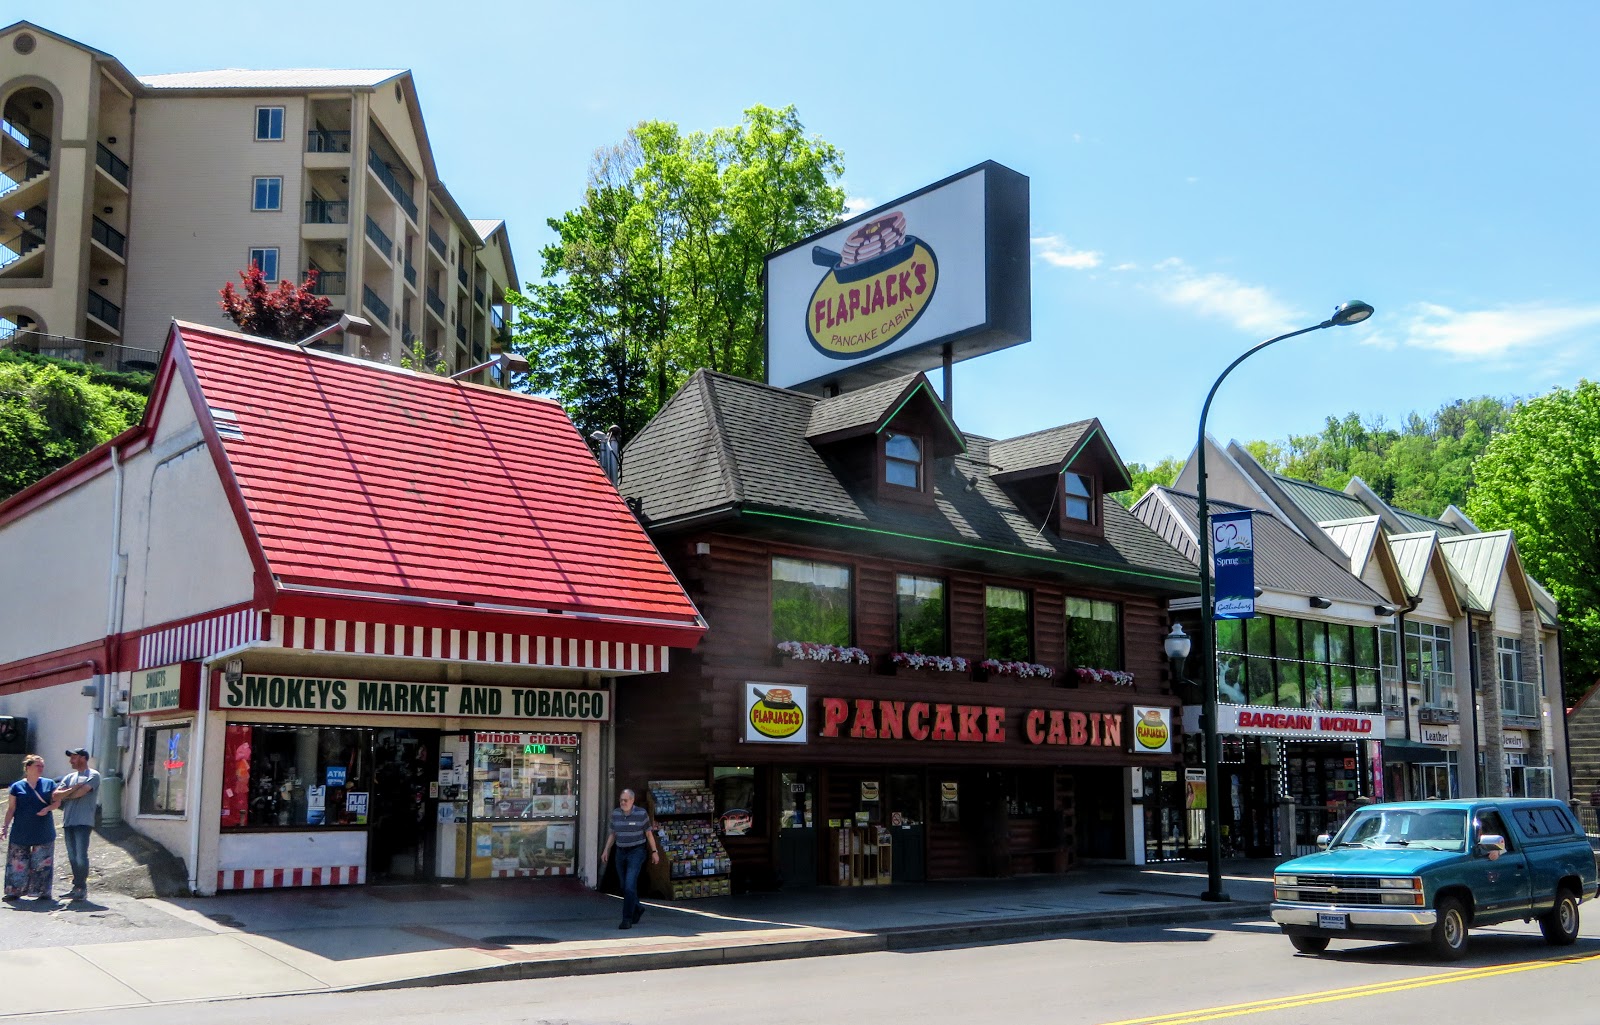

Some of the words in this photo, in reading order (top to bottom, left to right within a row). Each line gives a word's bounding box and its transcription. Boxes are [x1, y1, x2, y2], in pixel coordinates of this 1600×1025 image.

[815, 261, 927, 333] FLAPJACK'S
[831, 328, 878, 346] PANCAKE
[881, 303, 914, 334] CABIN
[227, 677, 347, 711] SMOKEYS
[358, 682, 449, 713] MARKET
[459, 687, 502, 716] AND
[512, 689, 603, 718] TOBACCO
[753, 709, 799, 725] FLAPJACK'S
[823, 697, 1005, 743] PANCAKE
[1026, 708, 1122, 747] CABIN
[1238, 711, 1313, 730] BARGAIN
[1319, 716, 1372, 733] WORLD
[459, 733, 520, 744] HMIDOR
[529, 735, 577, 745] CIGARS
[1137, 726, 1166, 739] FLAPJACK'S
[1425, 730, 1448, 742] Leather
[1502, 734, 1522, 747] Jewelry
[524, 744, 546, 754] ATM
[327, 770, 346, 778] ATM
[349, 795, 367, 805] PLAY
